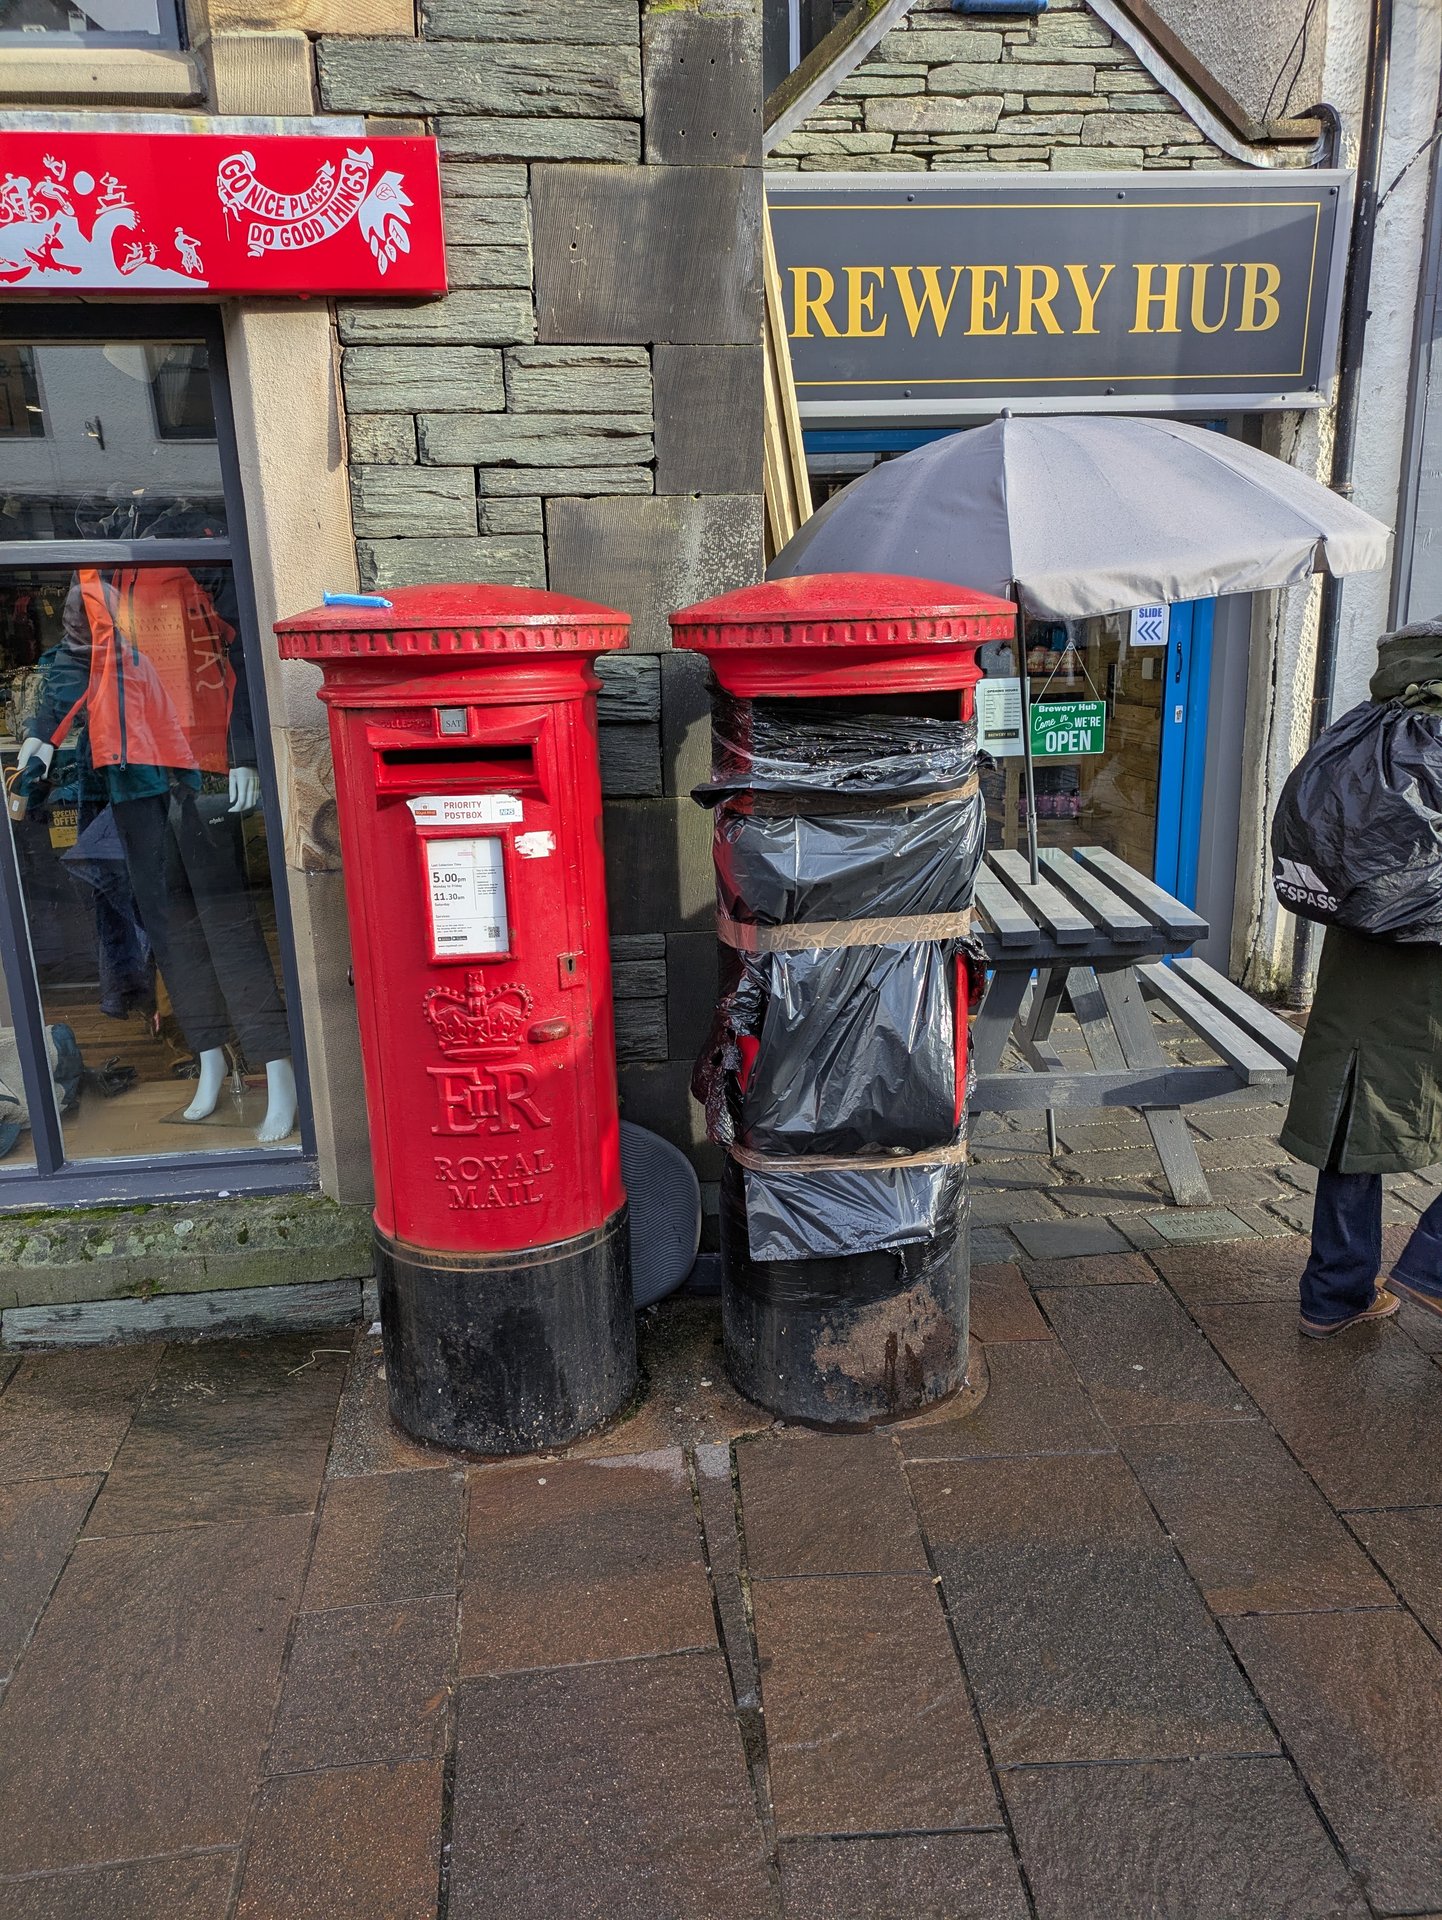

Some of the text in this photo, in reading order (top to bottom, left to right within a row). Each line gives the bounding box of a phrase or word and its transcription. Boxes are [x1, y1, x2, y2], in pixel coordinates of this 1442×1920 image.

[220, 159, 332, 218] GO NICE PLACES
[250, 163, 367, 248] DO GOOD THINGS
[778, 263, 1281, 339] REWERY HUB
[1139, 607, 1162, 618] SLIDE
[1038, 702, 1097, 713] Brewery Hub
[446, 720, 462, 728] SAT
[1034, 714, 1101, 731] Come in WE'RE
[1045, 729, 1092, 752] OPEN
[444, 801, 482, 809] PRIORITY
[445, 811, 482, 820] POSTBOX
[433, 1149, 554, 1182] ROYAL
[448, 1179, 544, 1210] MAIL
